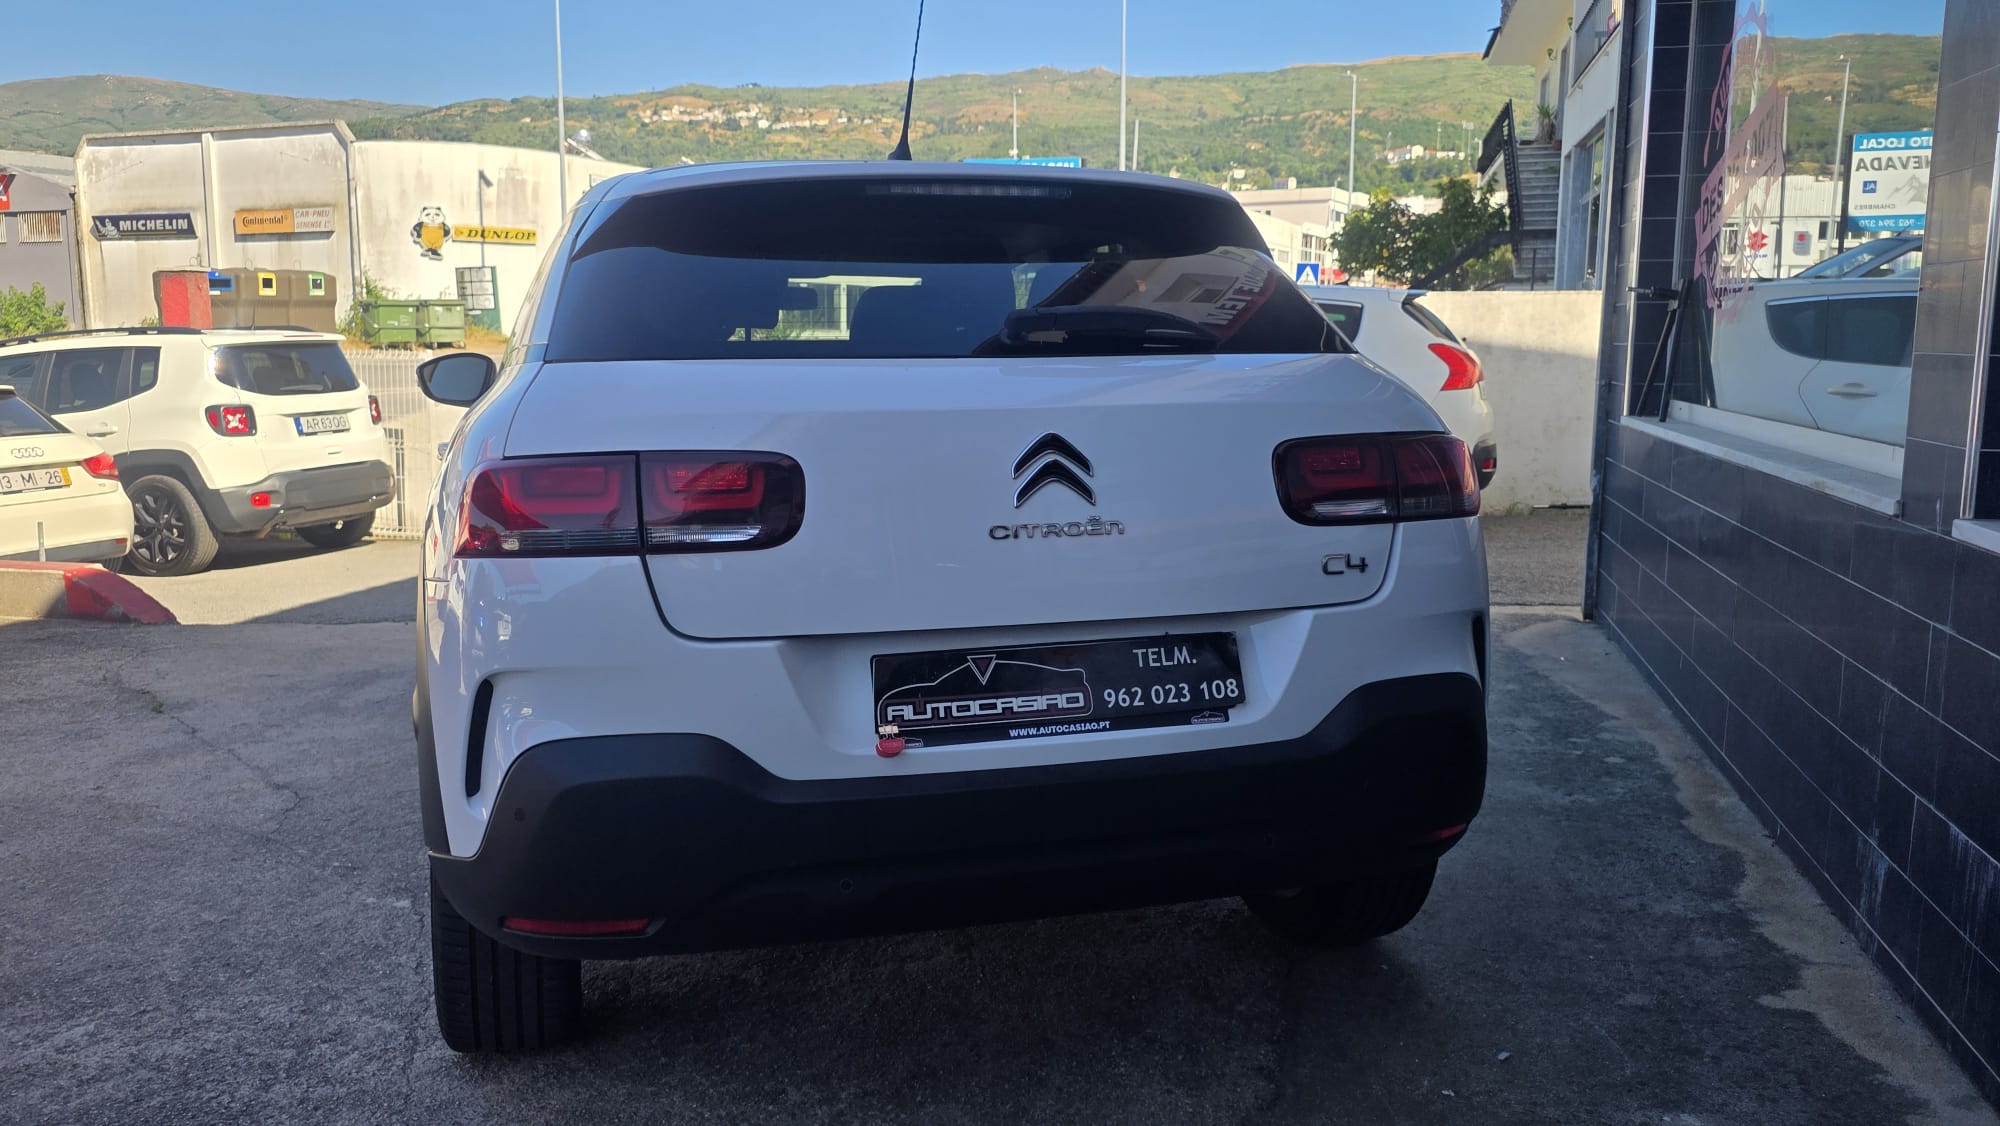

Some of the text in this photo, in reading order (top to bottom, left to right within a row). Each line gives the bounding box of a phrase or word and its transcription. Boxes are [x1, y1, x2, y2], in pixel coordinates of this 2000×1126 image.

[119, 218, 188, 231] MICHELIN
[242, 215, 284, 228] Continental
[467, 229, 536, 240] DUNLOP
[1321, 553, 1368, 575] C4
[1132, 646, 1197, 668] TELM.
[1103, 679, 1239, 708] 962 023 108
[886, 692, 1085, 721] AUTOCASIAO
[1009, 720, 1111, 737] WWW.AUTOCASIAO.PT
